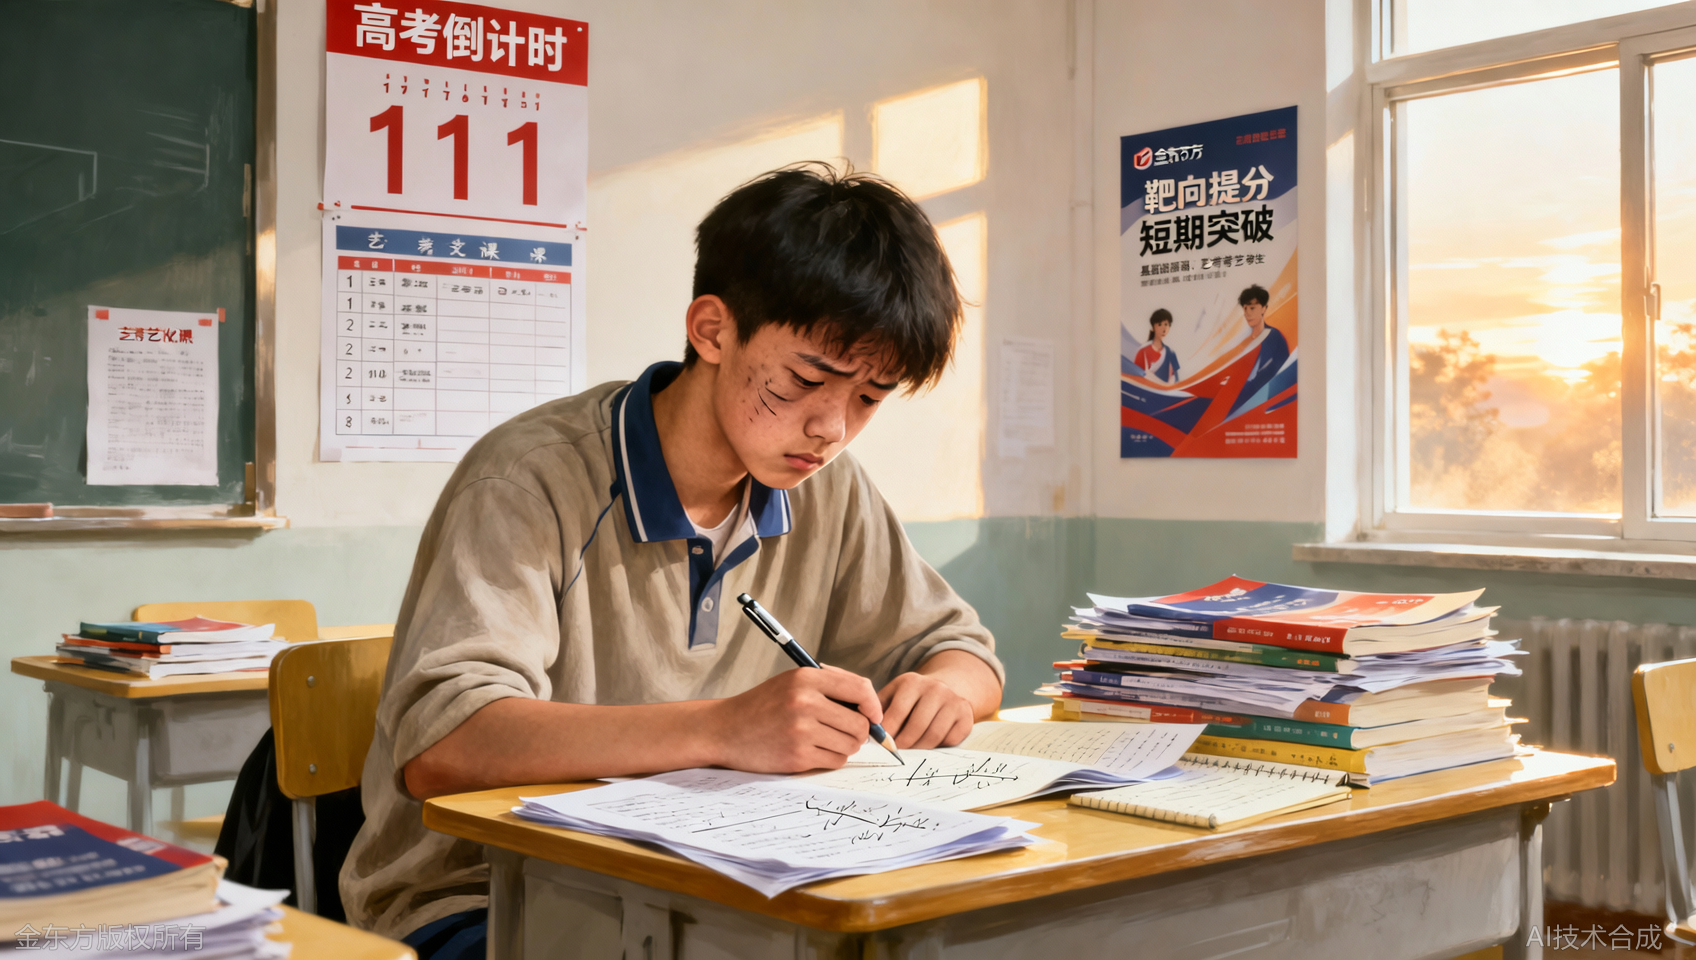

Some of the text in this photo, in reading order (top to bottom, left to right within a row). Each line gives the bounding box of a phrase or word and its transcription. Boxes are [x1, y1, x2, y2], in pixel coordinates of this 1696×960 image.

[354, 2, 567, 72] 高考倒计时
[1144, 164, 1275, 216] 靶向提分
[1139, 204, 1275, 257] 短期突破
